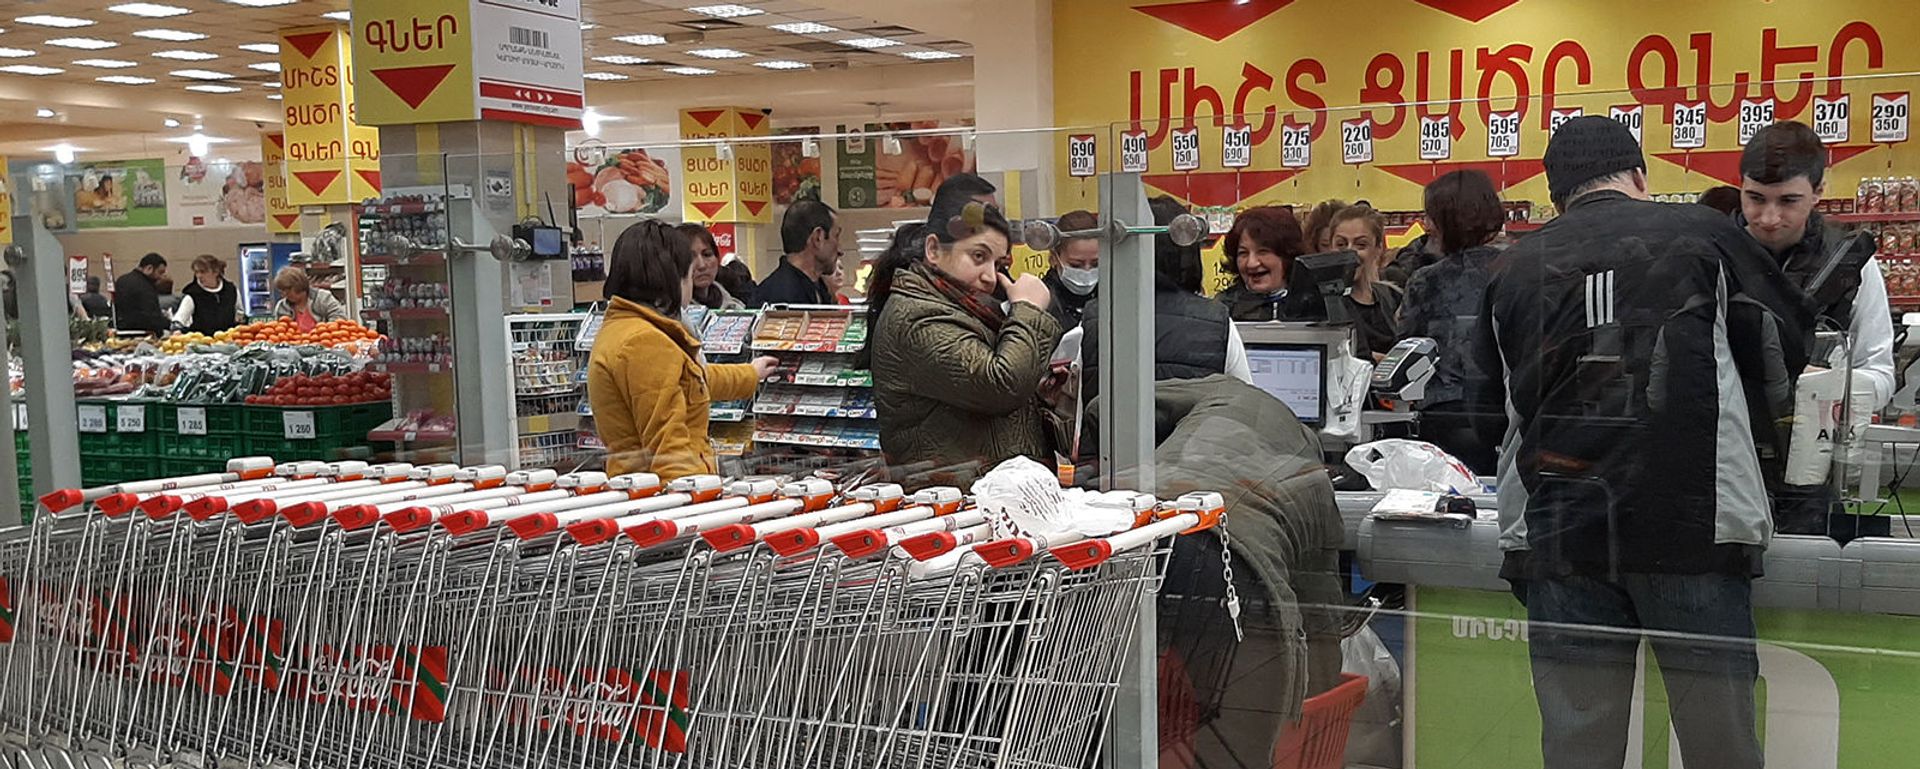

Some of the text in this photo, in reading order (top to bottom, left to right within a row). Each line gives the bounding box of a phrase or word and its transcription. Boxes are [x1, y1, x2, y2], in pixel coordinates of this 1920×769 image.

[365, 14, 457, 53] ԳՆԵՐ
[284, 65, 337, 89] ՄԻՇՏ
[1129, 21, 1883, 151] ՄԻՇՏ ՑԱԾՐ ԳՆԵՐ
[287, 103, 341, 127] ՑԱԾՐ
[1675, 107, 1705, 126] 345
[1741, 104, 1774, 123] 395
[1815, 103, 1847, 121] 370
[1873, 104, 1906, 119] 290
[1422, 122, 1449, 138] 485
[1490, 118, 1518, 135] 595
[1815, 121, 1838, 135] 460
[1875, 118, 1899, 131] 350
[1225, 132, 1250, 147] 450
[1284, 131, 1309, 146] 275
[1344, 126, 1370, 143] 220
[1674, 126, 1696, 139] 380
[1071, 142, 1095, 156] 690
[1123, 137, 1147, 153] 490
[1174, 134, 1198, 149] 550
[1345, 143, 1364, 155] 260
[1422, 139, 1441, 151] 570
[1490, 135, 1510, 148] 705
[290, 140, 341, 161] ԳՆԵՐ
[352, 140, 379, 160] ԳՆ
[1175, 151, 1191, 162] 750
[1225, 147, 1242, 159] 690
[1284, 147, 1302, 158] 330
[686, 157, 729, 172] ՑԱԾՐ
[738, 157, 768, 172] ՑԱԾՐ
[1072, 158, 1088, 168] 870
[1124, 154, 1140, 165] 650
[268, 175, 287, 188] ՑԱ
[739, 181, 768, 196] ԳՆԵՐ
[688, 182, 729, 197] ԳՆԵՐ
[1024, 253, 1043, 271] 170
